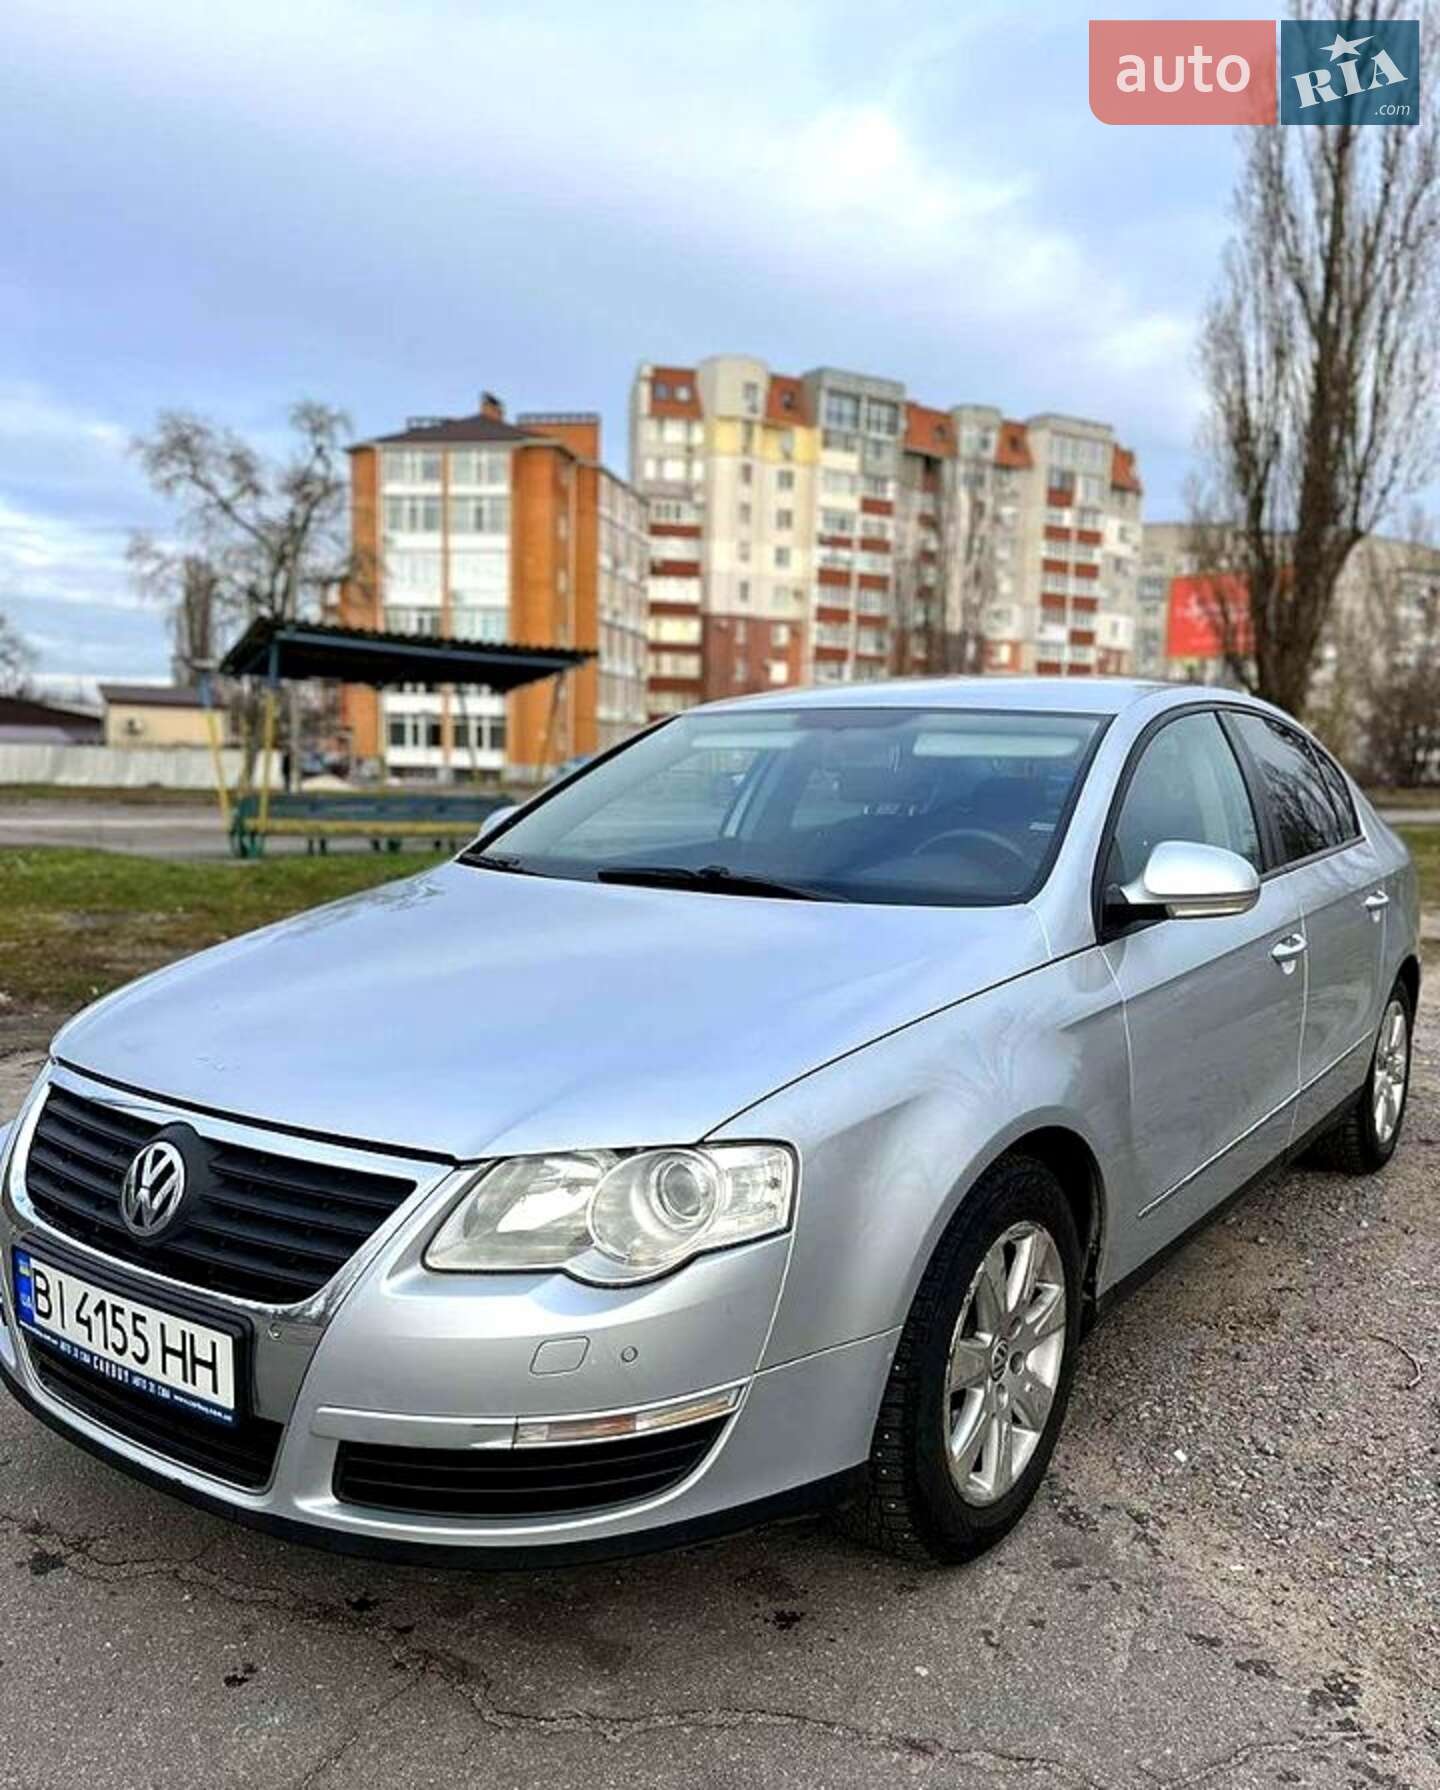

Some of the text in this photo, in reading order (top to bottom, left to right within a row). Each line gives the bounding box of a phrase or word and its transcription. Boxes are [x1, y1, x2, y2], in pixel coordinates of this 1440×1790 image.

[32, 1267, 219, 1396] BI 4155 HH
